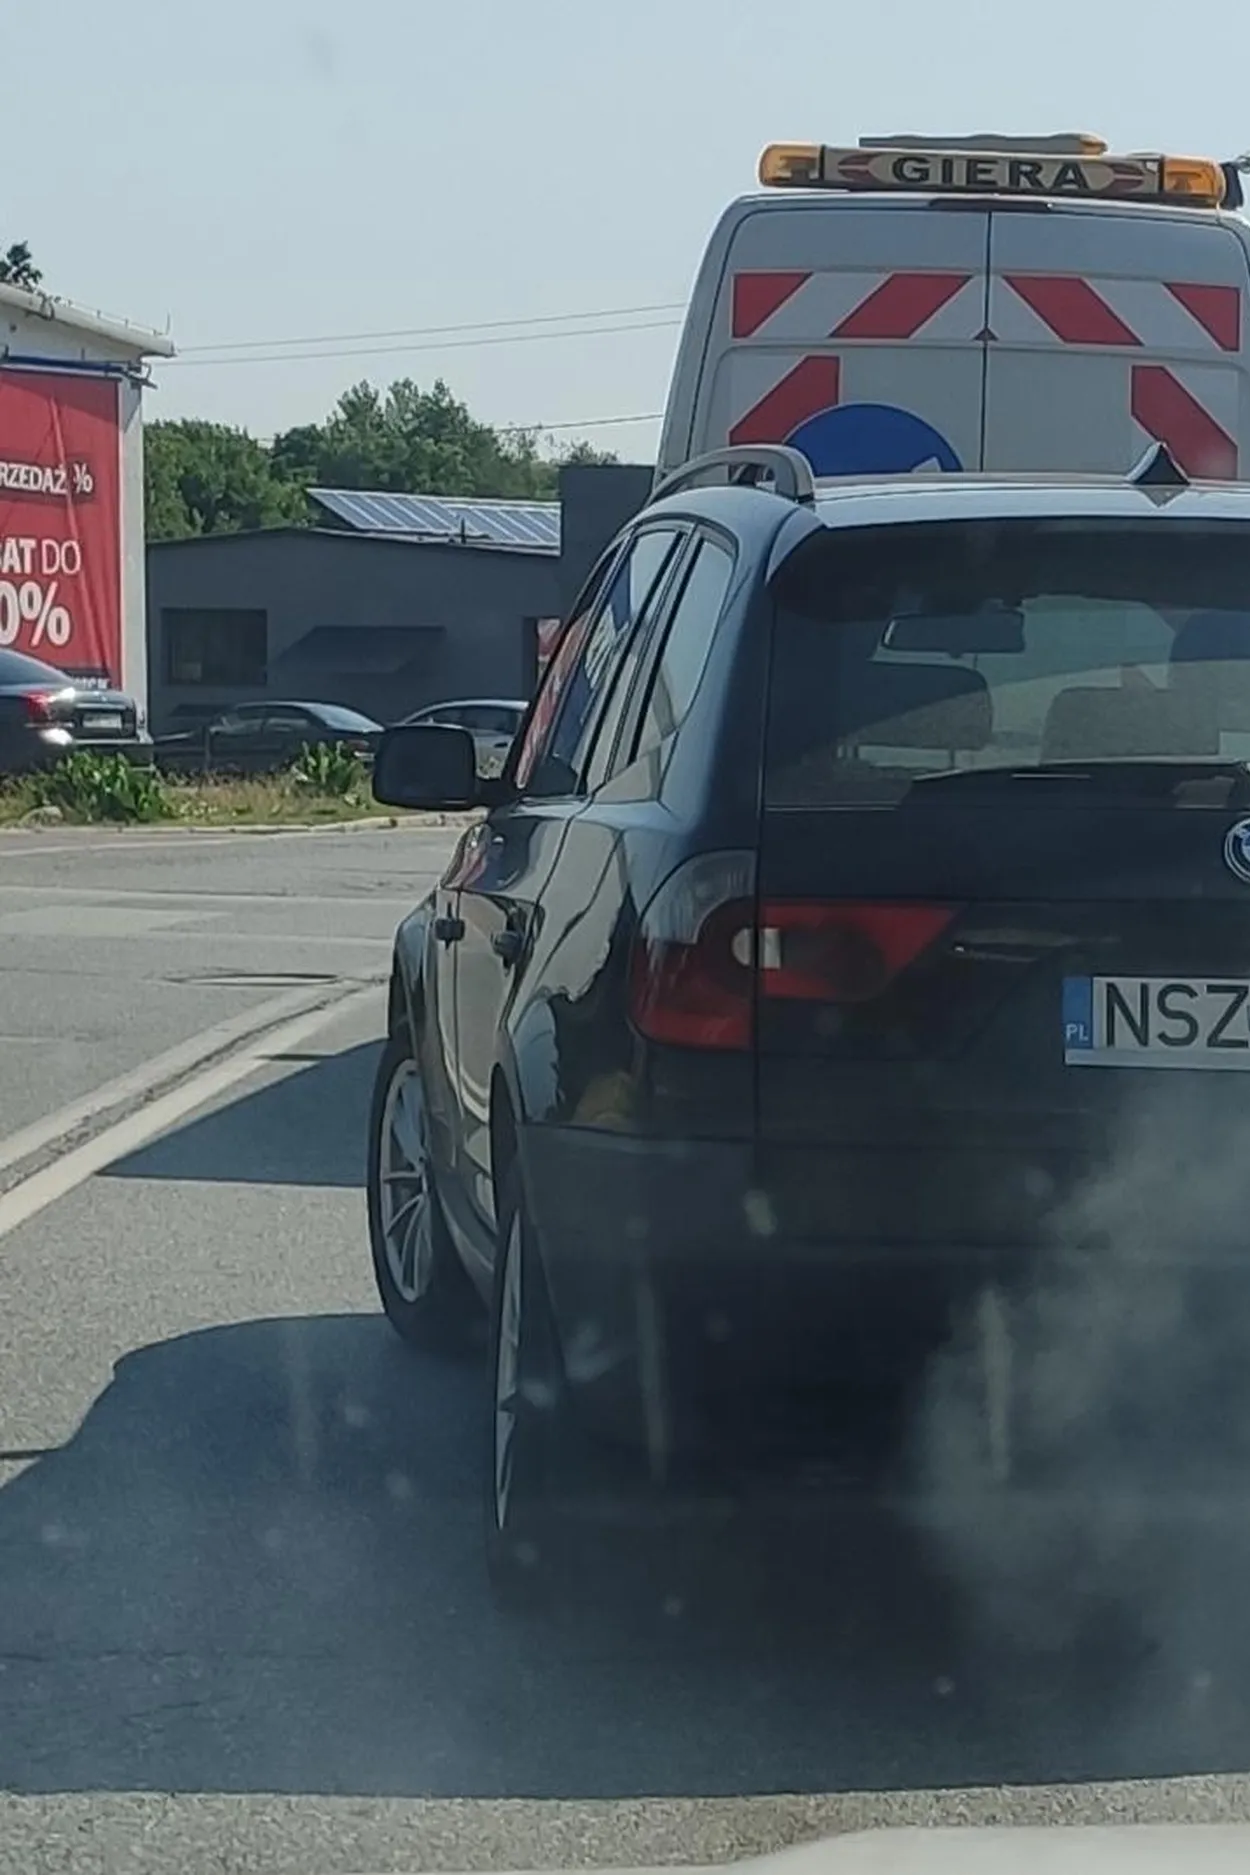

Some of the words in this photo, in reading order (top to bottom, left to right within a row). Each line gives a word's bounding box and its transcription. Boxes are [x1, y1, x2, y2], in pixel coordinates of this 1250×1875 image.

[892, 156, 1089, 190] GIERA
[0, 537, 37, 574] AT
[41, 538, 81, 575] DO
[1064, 1023, 1090, 1042] PL
[1105, 982, 1250, 1050] NSZ
